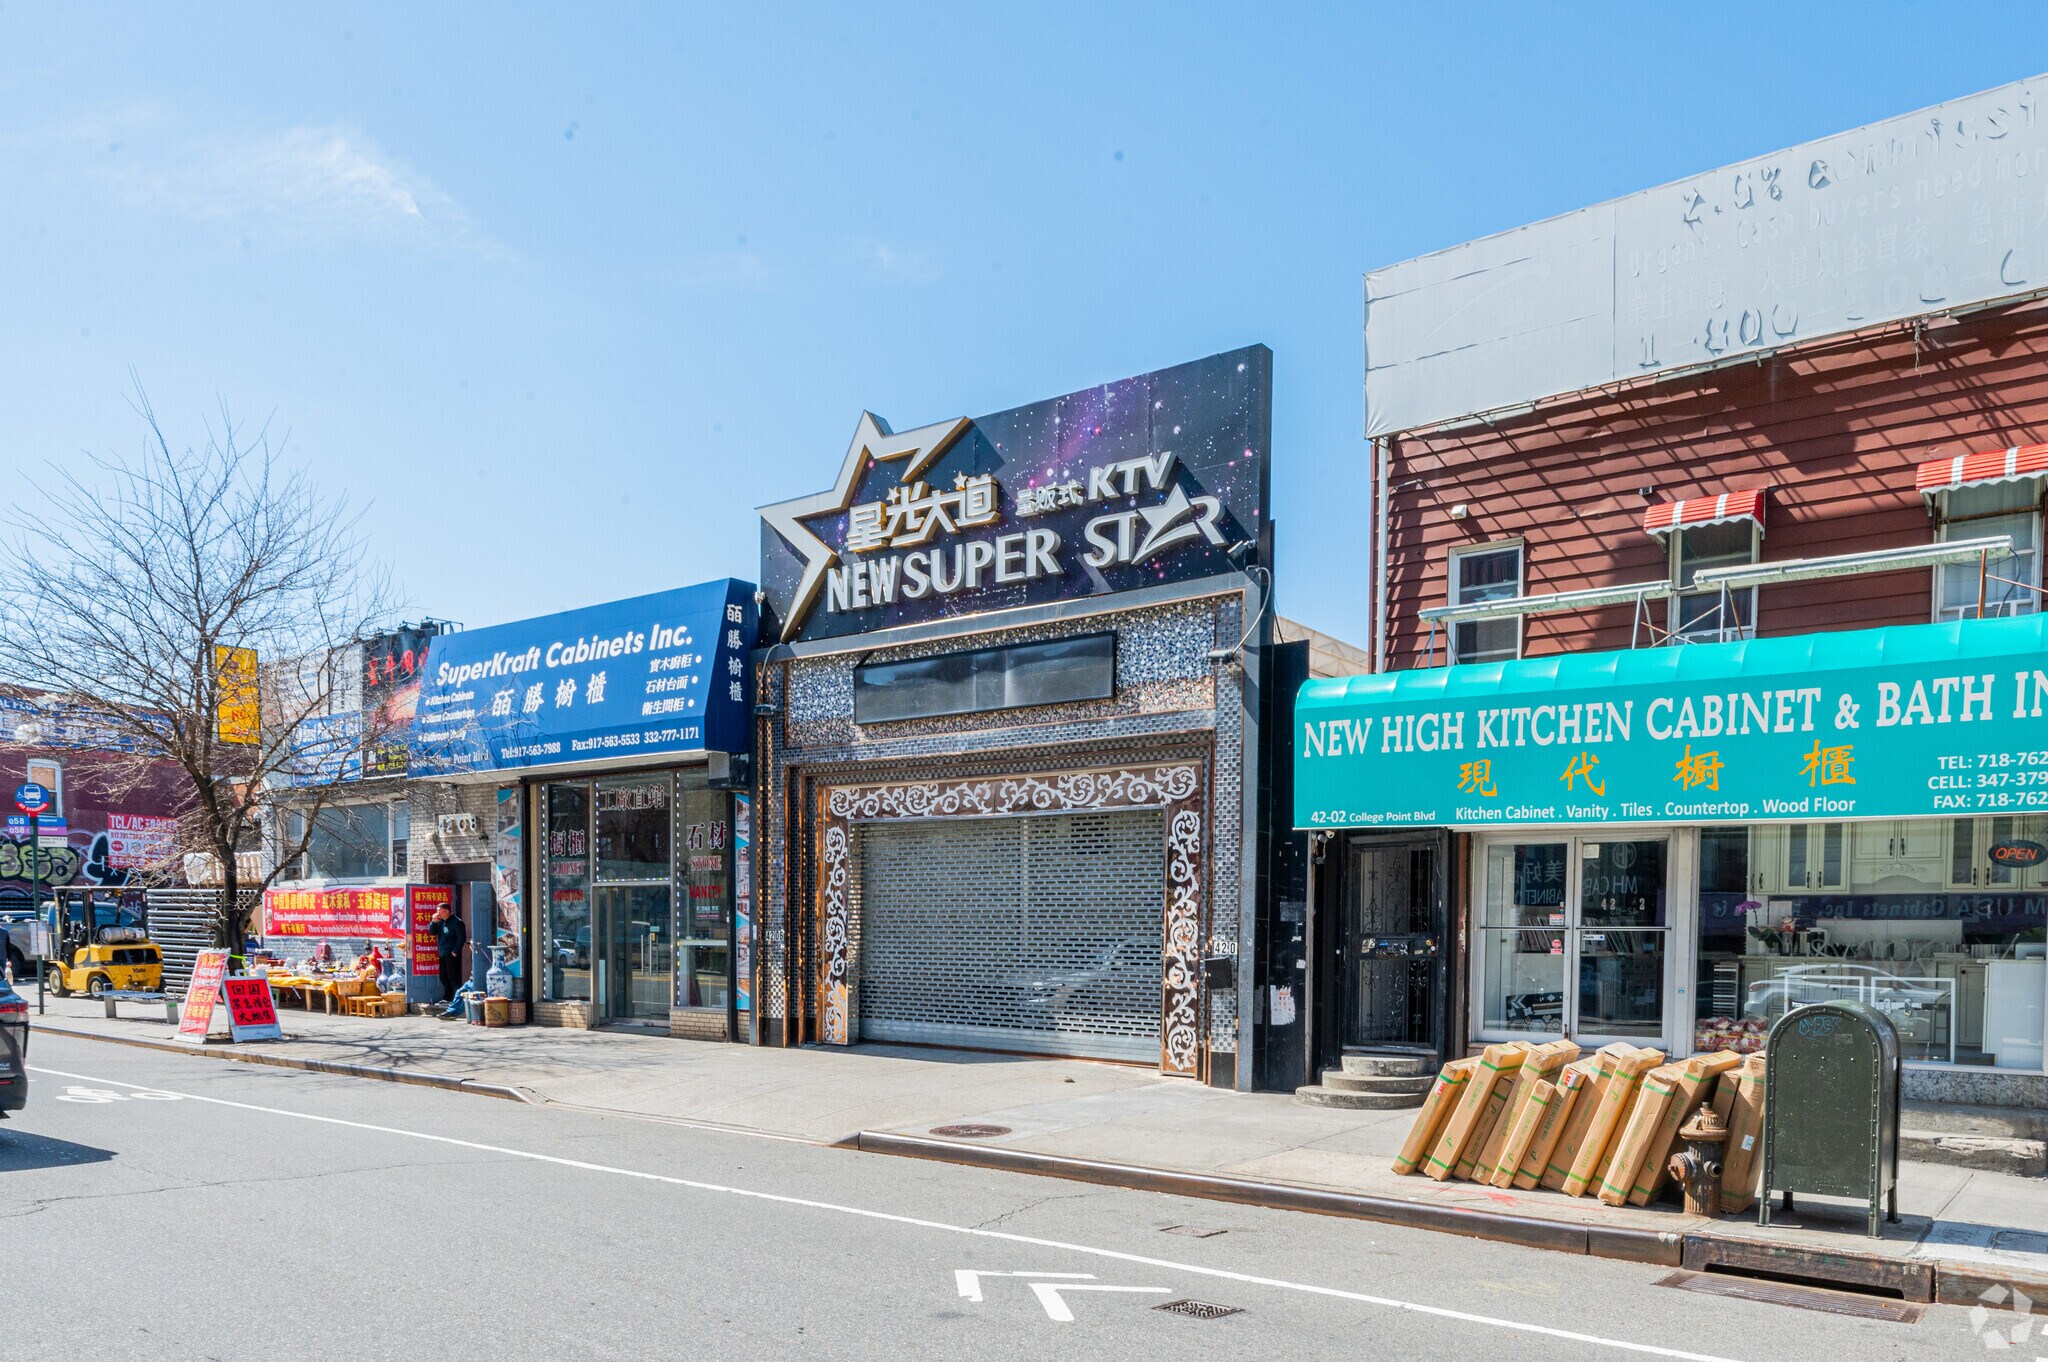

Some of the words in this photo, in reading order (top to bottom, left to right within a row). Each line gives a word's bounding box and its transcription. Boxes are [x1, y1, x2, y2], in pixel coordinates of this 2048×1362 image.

[1738, 213, 1794, 249] Cash
[1808, 186, 1899, 231] buyers
[1917, 155, 1982, 203] need
[1088, 451, 1179, 501] KTV
[847, 470, 1001, 552] 星光大道
[827, 555, 901, 614] NEW
[902, 527, 1066, 598] SUPER
[436, 646, 541, 689] SuperKraft
[545, 631, 645, 668] Cabinets
[649, 623, 693, 651] Inc.
[645, 675, 689, 694] 石材台面
[451, 690, 475, 702] Cabinets
[1304, 718, 1373, 758] NEW
[1381, 711, 1465, 754] HIGH
[1477, 700, 1633, 748] KITCHEN
[1647, 688, 1821, 740] CABINET
[1834, 693, 1860, 730] &
[1876, 674, 1995, 727] BATH
[501, 741, 561, 759] Tel:917-563-7988
[572, 733, 640, 752] Fax:917-563-5533
[644, 727, 700, 745] 332-777-1171
[453, 752, 471, 764] Point
[1937, 756, 1972, 770] TEL:
[1927, 775, 1971, 790] CELL:
[1455, 806, 1502, 821] Kitchen
[1505, 804, 1555, 819] Cabinet
[1566, 804, 1609, 821] Vanity
[1620, 803, 1653, 818] Tiles
[1665, 801, 1750, 818] Countertop
[1762, 798, 1810, 814] Wood
[1813, 797, 1856, 812] Floor
[1933, 794, 1971, 809] FAX:
[8, 817, 25, 825] Q58
[110, 815, 144, 830] TCL/AC
[1310, 810, 1347, 823] 42-02
[1349, 810, 1384, 822] College
[1386, 810, 1412, 822] Point
[1414, 810, 1436, 821] Blvd
[686, 821, 727, 850] 石材
[1994, 847, 2039, 860] OPEN
[550, 861, 585, 876] CABINET
[690, 855, 722, 871] STONE
[689, 885, 723, 899] VANITY
[368, 912, 390, 922] exhibition
[1213, 942, 1237, 954] 420
